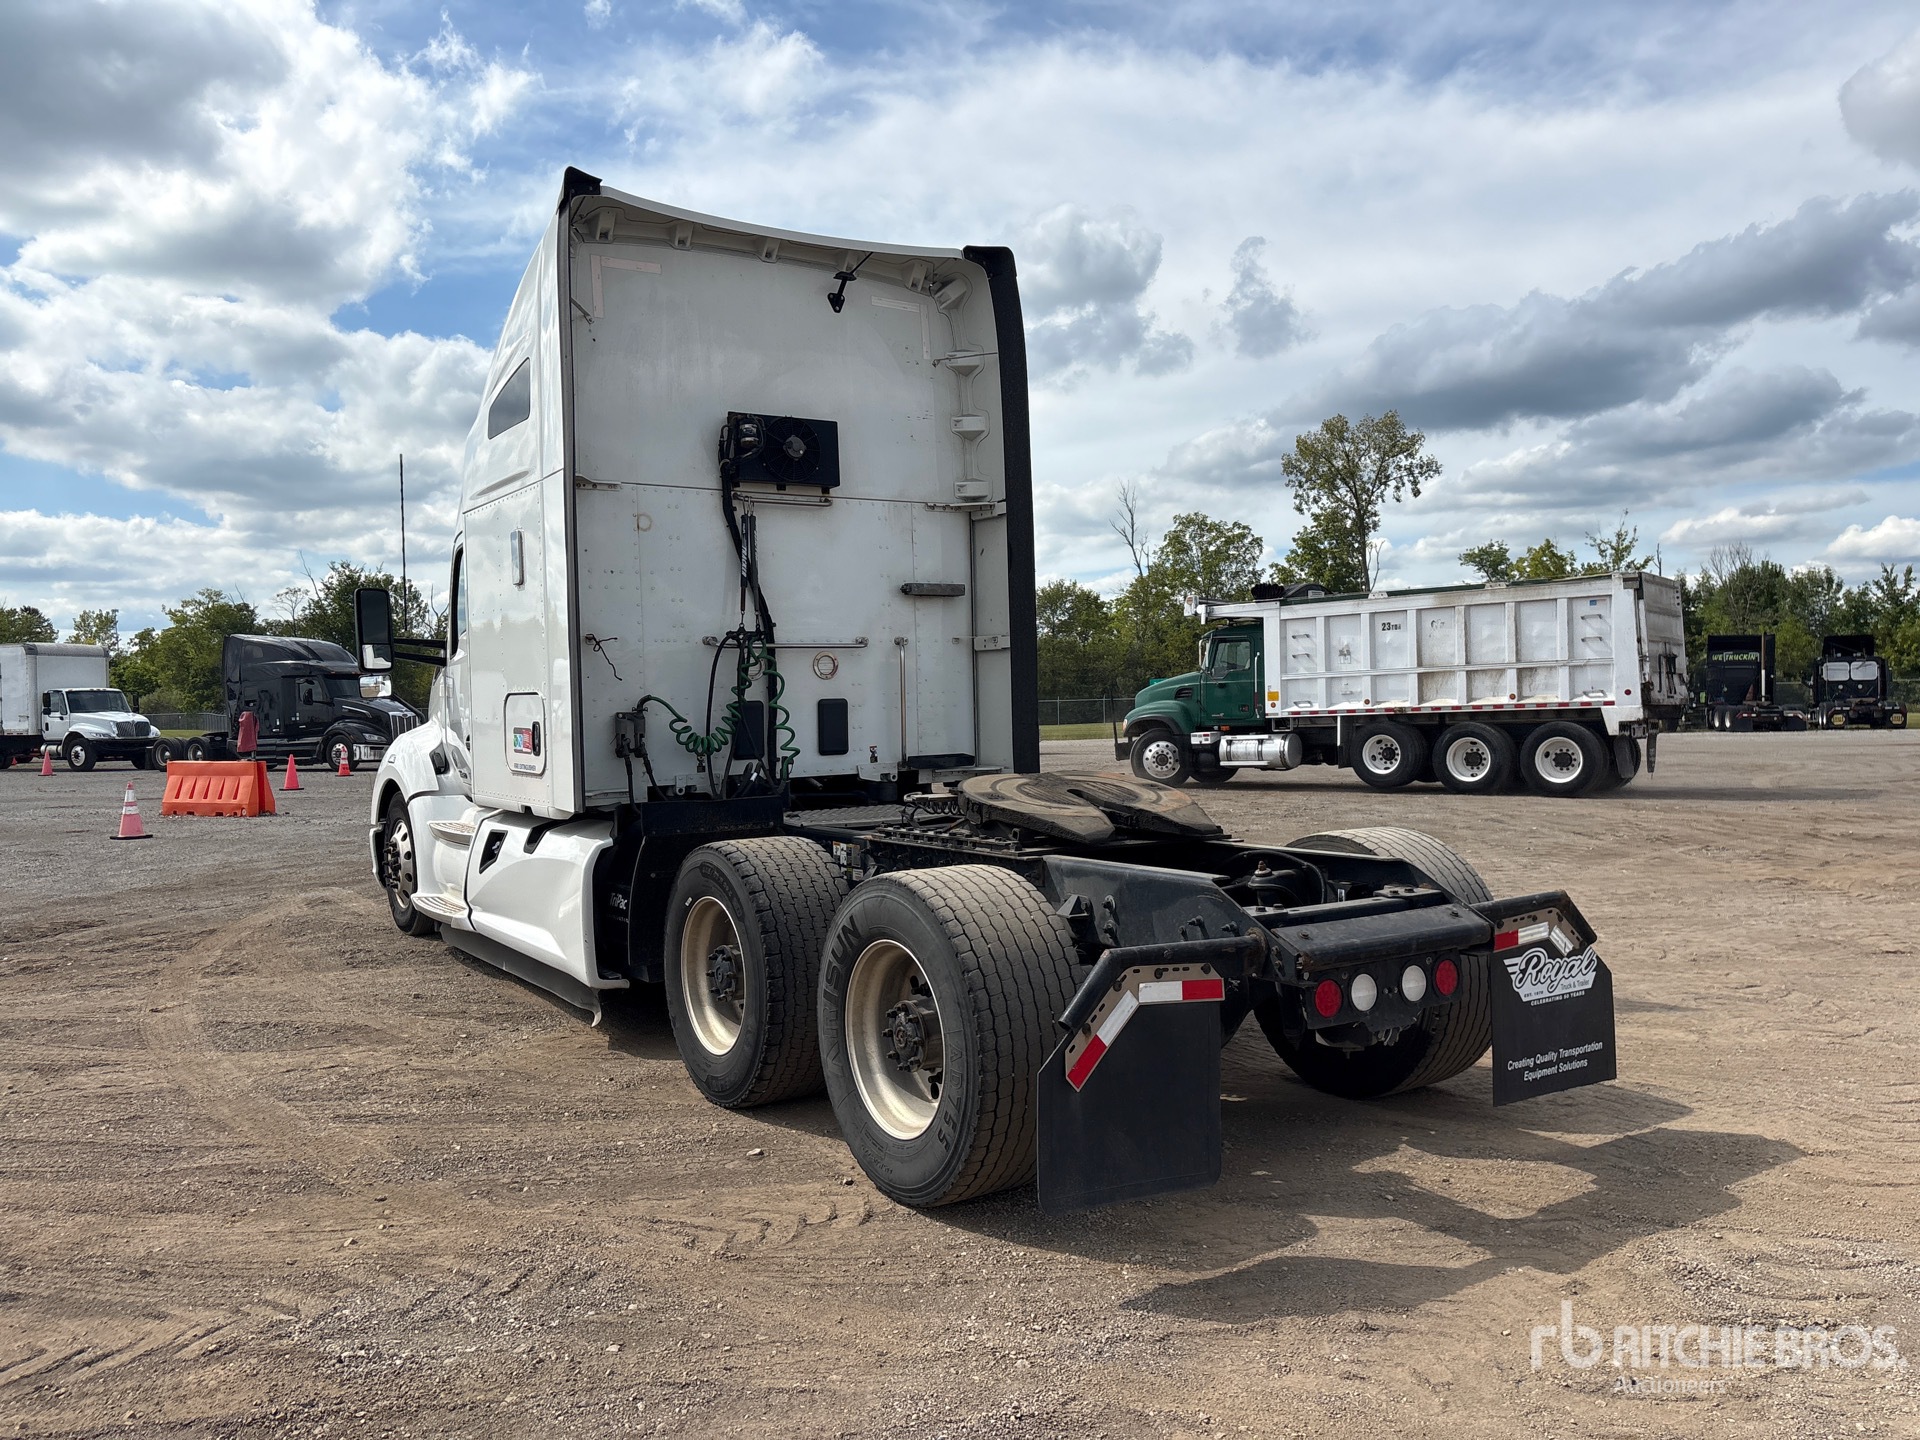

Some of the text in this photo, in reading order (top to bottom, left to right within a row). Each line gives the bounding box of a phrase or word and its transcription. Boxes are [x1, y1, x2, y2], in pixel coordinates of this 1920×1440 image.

[1514, 945, 1597, 993] Royal
[1561, 981, 1572, 991] Truck
[1577, 978, 1590, 987] Trailer
[1530, 994, 1563, 1006] CELEBRATING
[1570, 990, 1585, 998] YEARS
[1507, 1041, 1603, 1070] Creating Quality Transportation
[1523, 1058, 1588, 1082] Equipment Solutions
